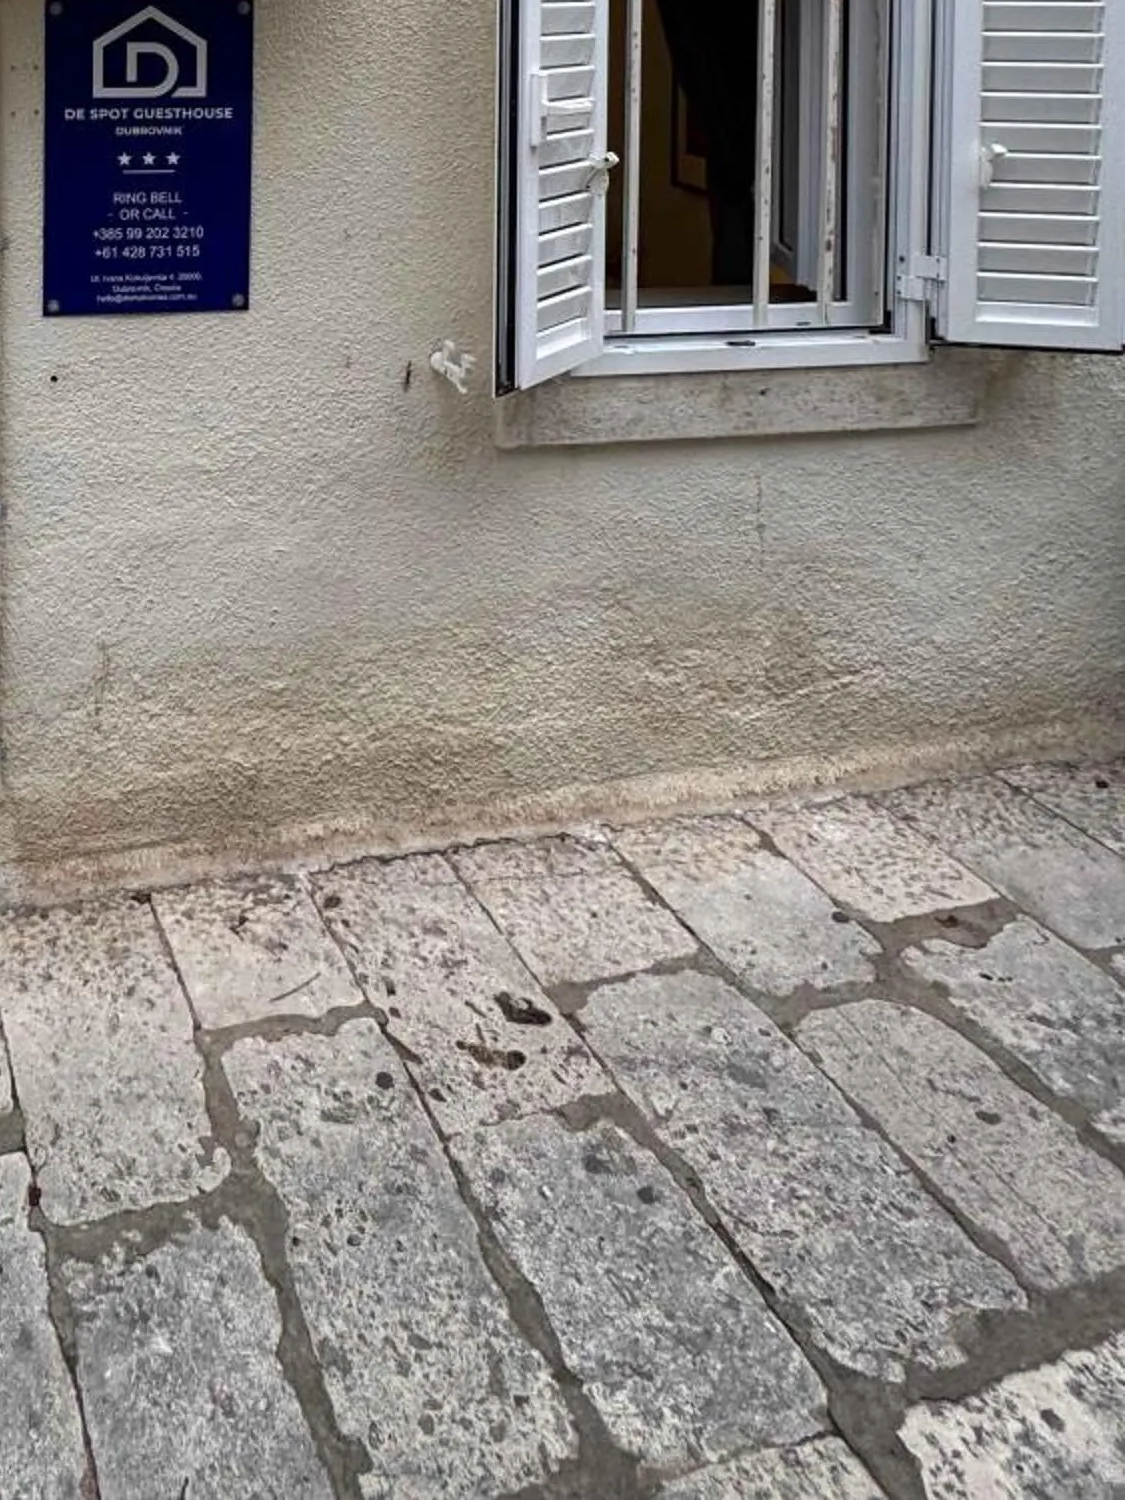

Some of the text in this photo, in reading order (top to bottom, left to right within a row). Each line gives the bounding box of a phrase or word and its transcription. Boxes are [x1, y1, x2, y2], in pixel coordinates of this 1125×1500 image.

[65, 107, 233, 120] DE SPOT GUESTHOUSE
[113, 191, 182, 204] RING BELL
[119, 207, 175, 220] OR CALL
[126, 227, 142, 239] 99
[173, 225, 204, 239] 3210
[149, 245, 172, 258] 731
